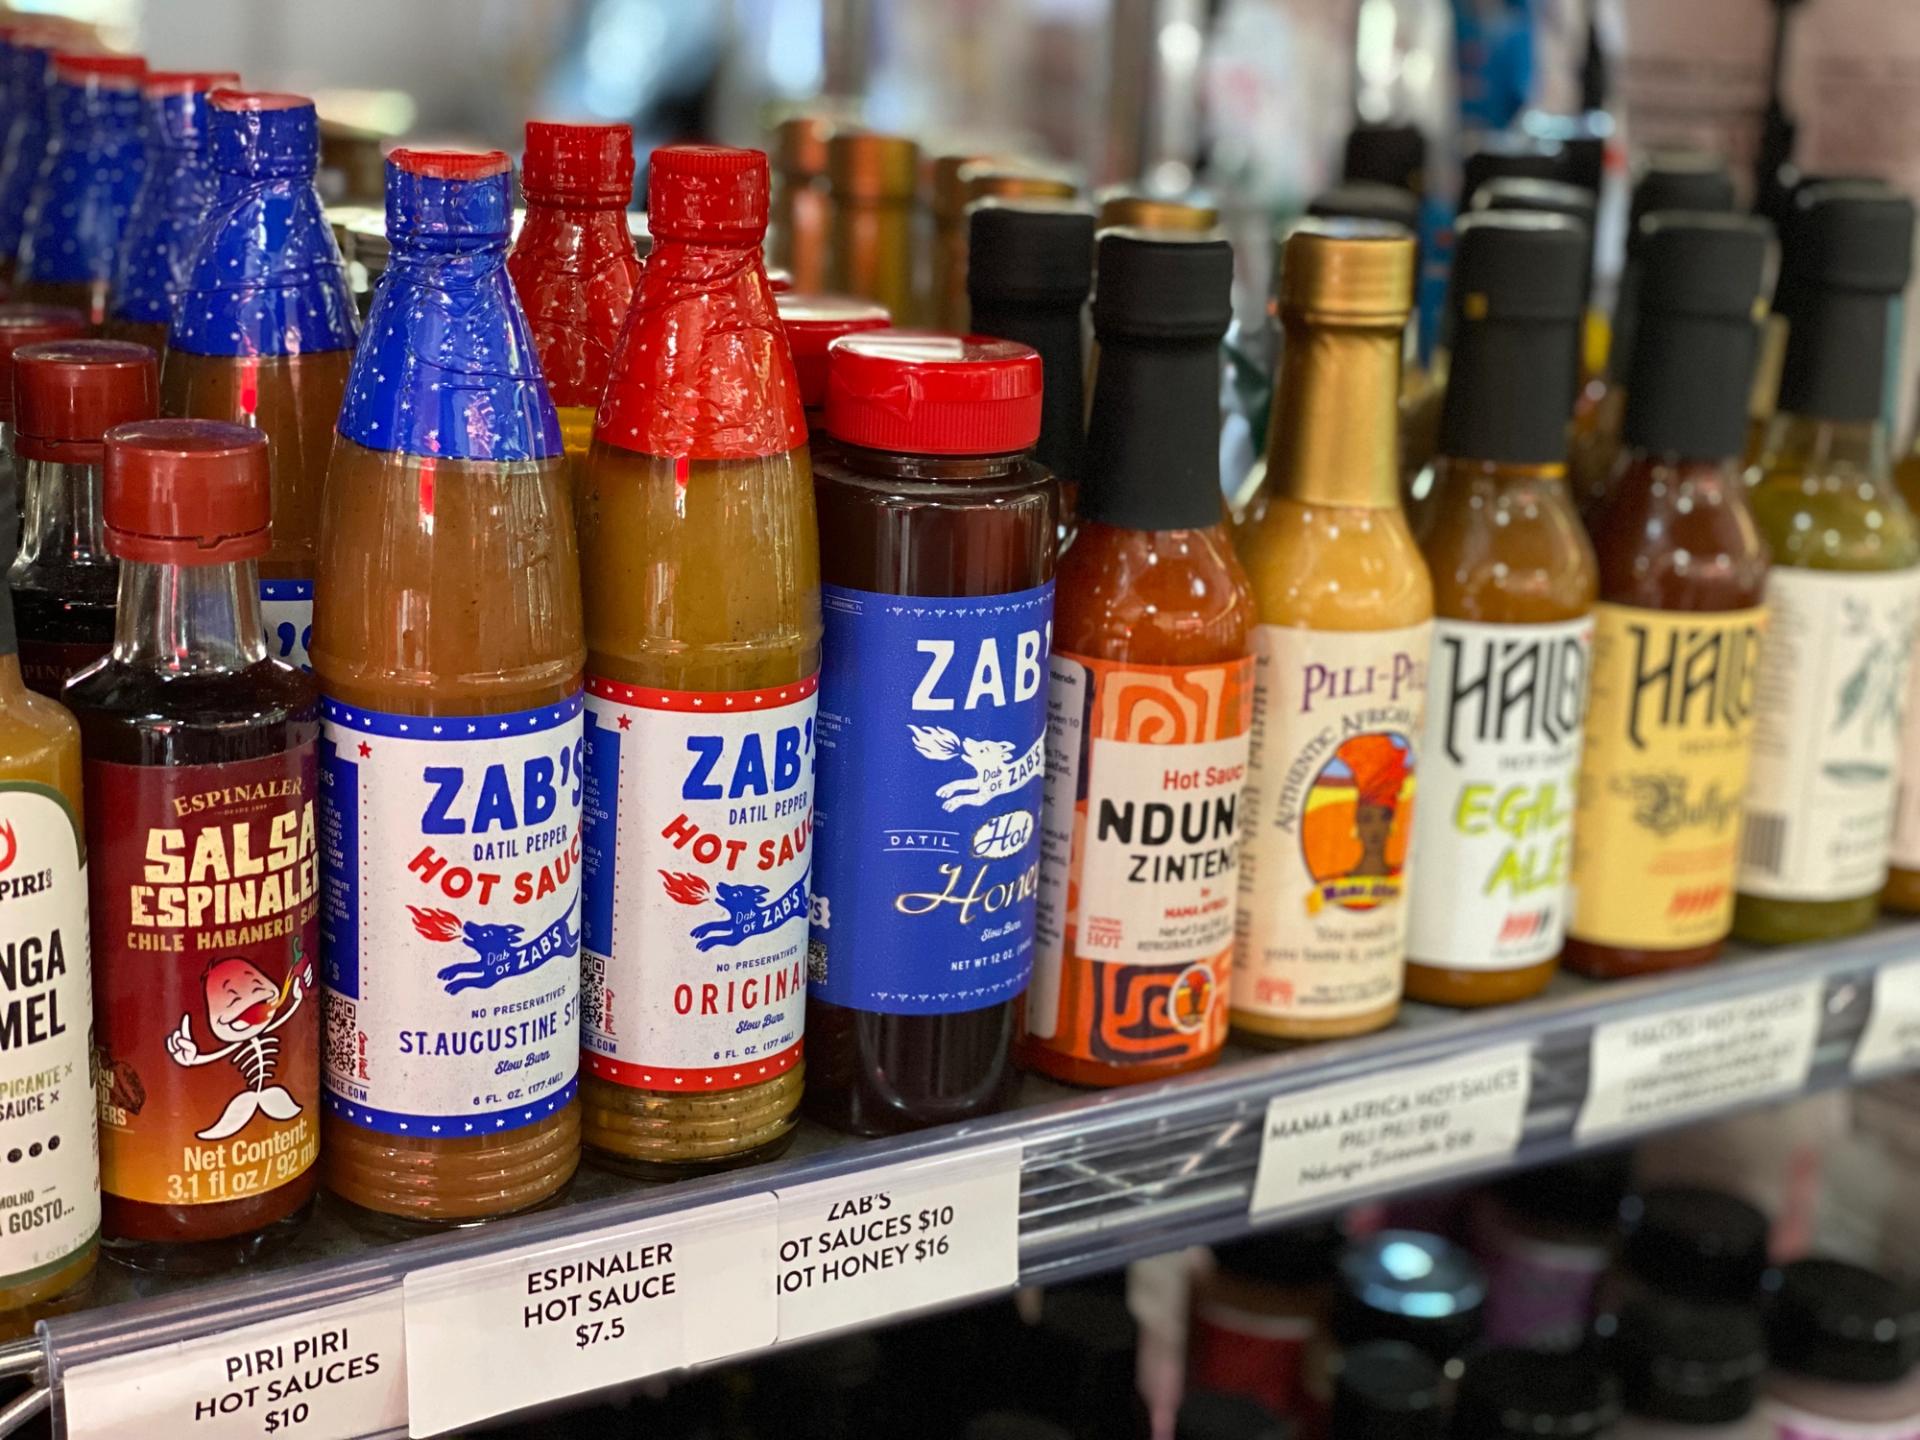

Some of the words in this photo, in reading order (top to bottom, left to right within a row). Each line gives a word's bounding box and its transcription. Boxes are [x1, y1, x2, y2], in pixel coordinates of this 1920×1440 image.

[682, 717, 815, 800] ZAB'
[173, 776, 302, 817] ESPINALER
[1163, 768, 1199, 791] Hot
[729, 804, 768, 826] DATIL
[775, 792, 808, 819] PEPPER
[144, 800, 317, 883] SALSA
[408, 845, 501, 905] HOT
[513, 815, 582, 905] SAUC
[473, 839, 519, 861] DATIL
[526, 825, 568, 854] PEPPER
[661, 813, 748, 871] HOT
[890, 834, 951, 847] DATIL
[131, 850, 320, 928] ESPINALER
[742, 922, 756, 934] OF
[762, 888, 801, 928] ZAB'S
[127, 931, 184, 952] CHILE
[196, 914, 294, 950] HABANERO
[495, 962, 511, 976] OF
[516, 926, 562, 970] ZAB'S
[1086, 930, 1123, 950] HOT
[716, 963, 730, 972] NO
[735, 944, 798, 970] PRESERVATIVES
[951, 959, 970, 971] NET
[974, 956, 988, 968] WT
[991, 952, 1001, 964] 12
[471, 1008, 487, 1019] NO
[493, 985, 566, 1016] PRESERVATIVES
[735, 1020, 761, 1034] Slow
[762, 1011, 785, 1028] Burn
[400, 1011, 558, 1056] ST.AUGUSTINE
[494, 1060, 522, 1075] Slow
[524, 1050, 551, 1068] Burn
[713, 1052, 721, 1060] 6
[725, 1049, 740, 1059] FL.
[473, 1096, 480, 1106] 6
[486, 1094, 501, 1104] FL.
[1269, 1111, 1333, 1140] MAMA
[1338, 1094, 1410, 1126] AFRICA
[167, 1173, 200, 1200] 3.1
[208, 1169, 226, 1197] fl
[232, 1168, 259, 1193] oz
[263, 1158, 272, 1186] /
[276, 1149, 298, 1180] 92
[301, 1132, 316, 1167] ml
[184, 1143, 227, 1172] Net
[818, 1213, 912, 1254] SAUCES
[918, 1205, 954, 1233] $10
[526, 1242, 674, 1295] ESPINALER
[822, 1243, 910, 1284] HONEY
[914, 1234, 949, 1262] $16
[523, 1294, 584, 1329] HOT
[588, 1273, 677, 1314] SAUCE
[575, 1318, 626, 1349] $7.5
[226, 1345, 284, 1381] PIRI
[294, 1328, 349, 1363] PIRI
[194, 1386, 260, 1421] HOT
[267, 1353, 380, 1403] SAUCES
[264, 1402, 310, 1434] $10
